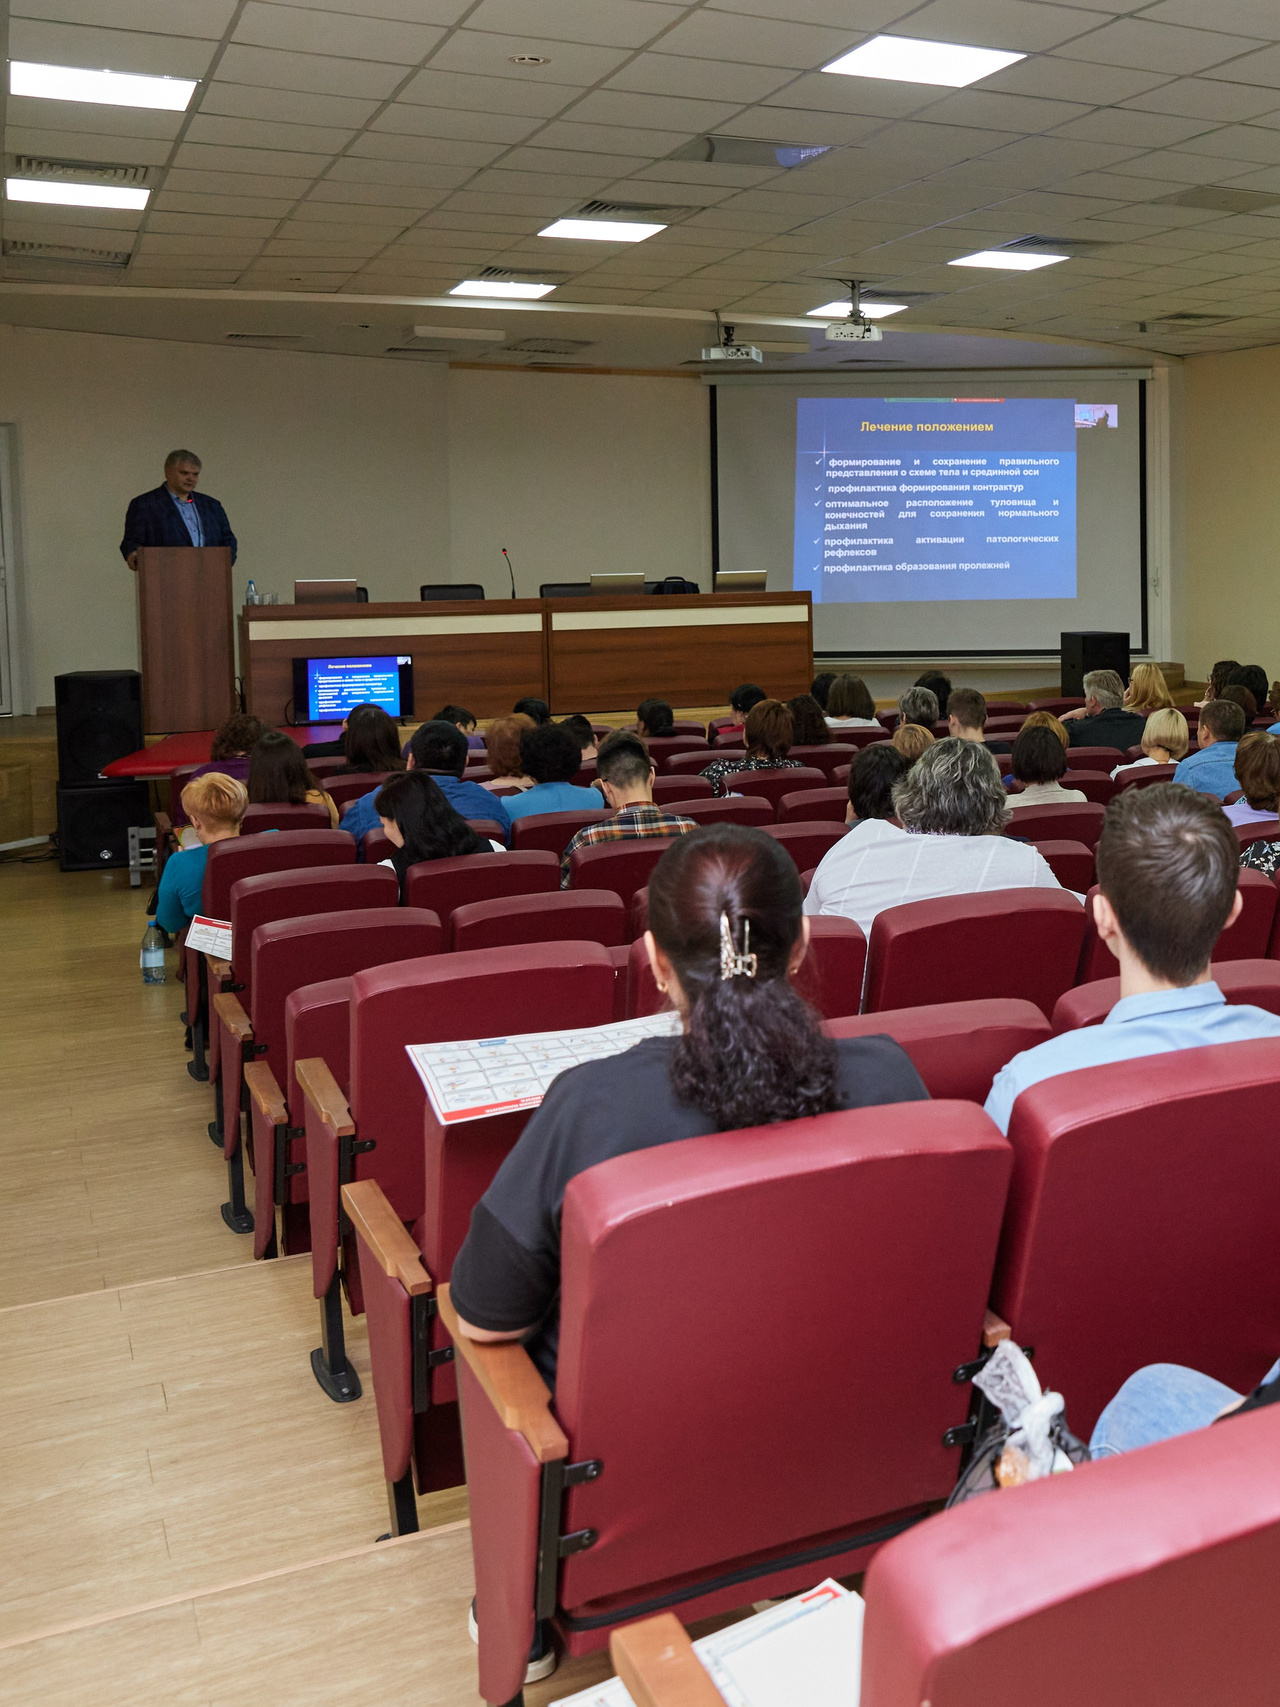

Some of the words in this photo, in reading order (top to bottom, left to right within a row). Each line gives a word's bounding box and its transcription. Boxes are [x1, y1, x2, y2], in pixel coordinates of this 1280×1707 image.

[860, 422, 913, 432] Лечение
[916, 423, 994, 432] положением
[828, 458, 901, 468] формирование
[999, 458, 1060, 467] правильного
[826, 470, 898, 478] представления
[970, 468, 1020, 477] срединной
[828, 484, 897, 494] профилактика
[899, 483, 970, 492] формирования
[972, 484, 1024, 492] контрактур
[906, 500, 974, 508] расположение
[990, 499, 1036, 508] туловища
[825, 510, 885, 519] конечностей
[898, 511, 917, 519] для
[930, 510, 985, 519] сохранения
[824, 522, 868, 531] дыхания
[824, 538, 894, 547] профилактика
[824, 548, 877, 558] рефлексов
[824, 564, 893, 574] профилактика
[896, 562, 957, 572] образования
[959, 561, 1010, 571] пролежней
